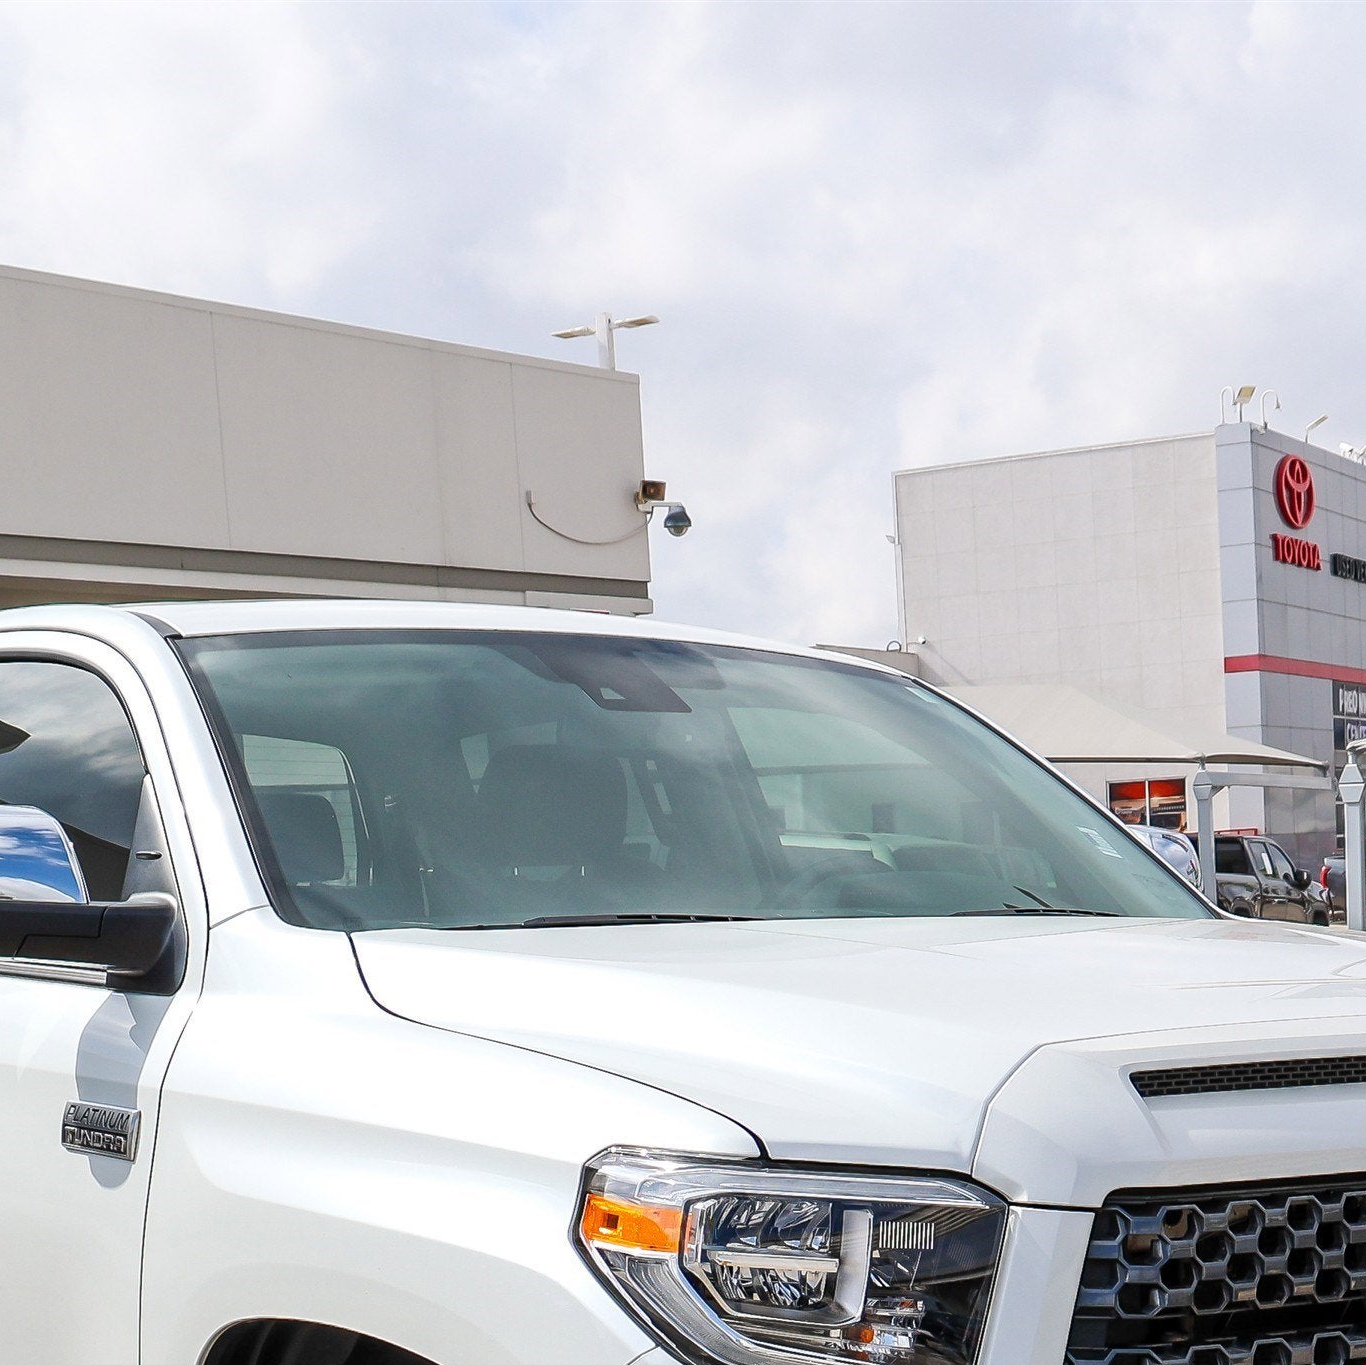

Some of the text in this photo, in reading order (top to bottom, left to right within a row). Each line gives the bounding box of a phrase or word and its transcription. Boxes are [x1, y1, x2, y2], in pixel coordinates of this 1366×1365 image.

[1271, 533, 1322, 571] TOYOTA
[65, 1104, 131, 1132] PLATINUM
[64, 1125, 127, 1153] TUNDRA
